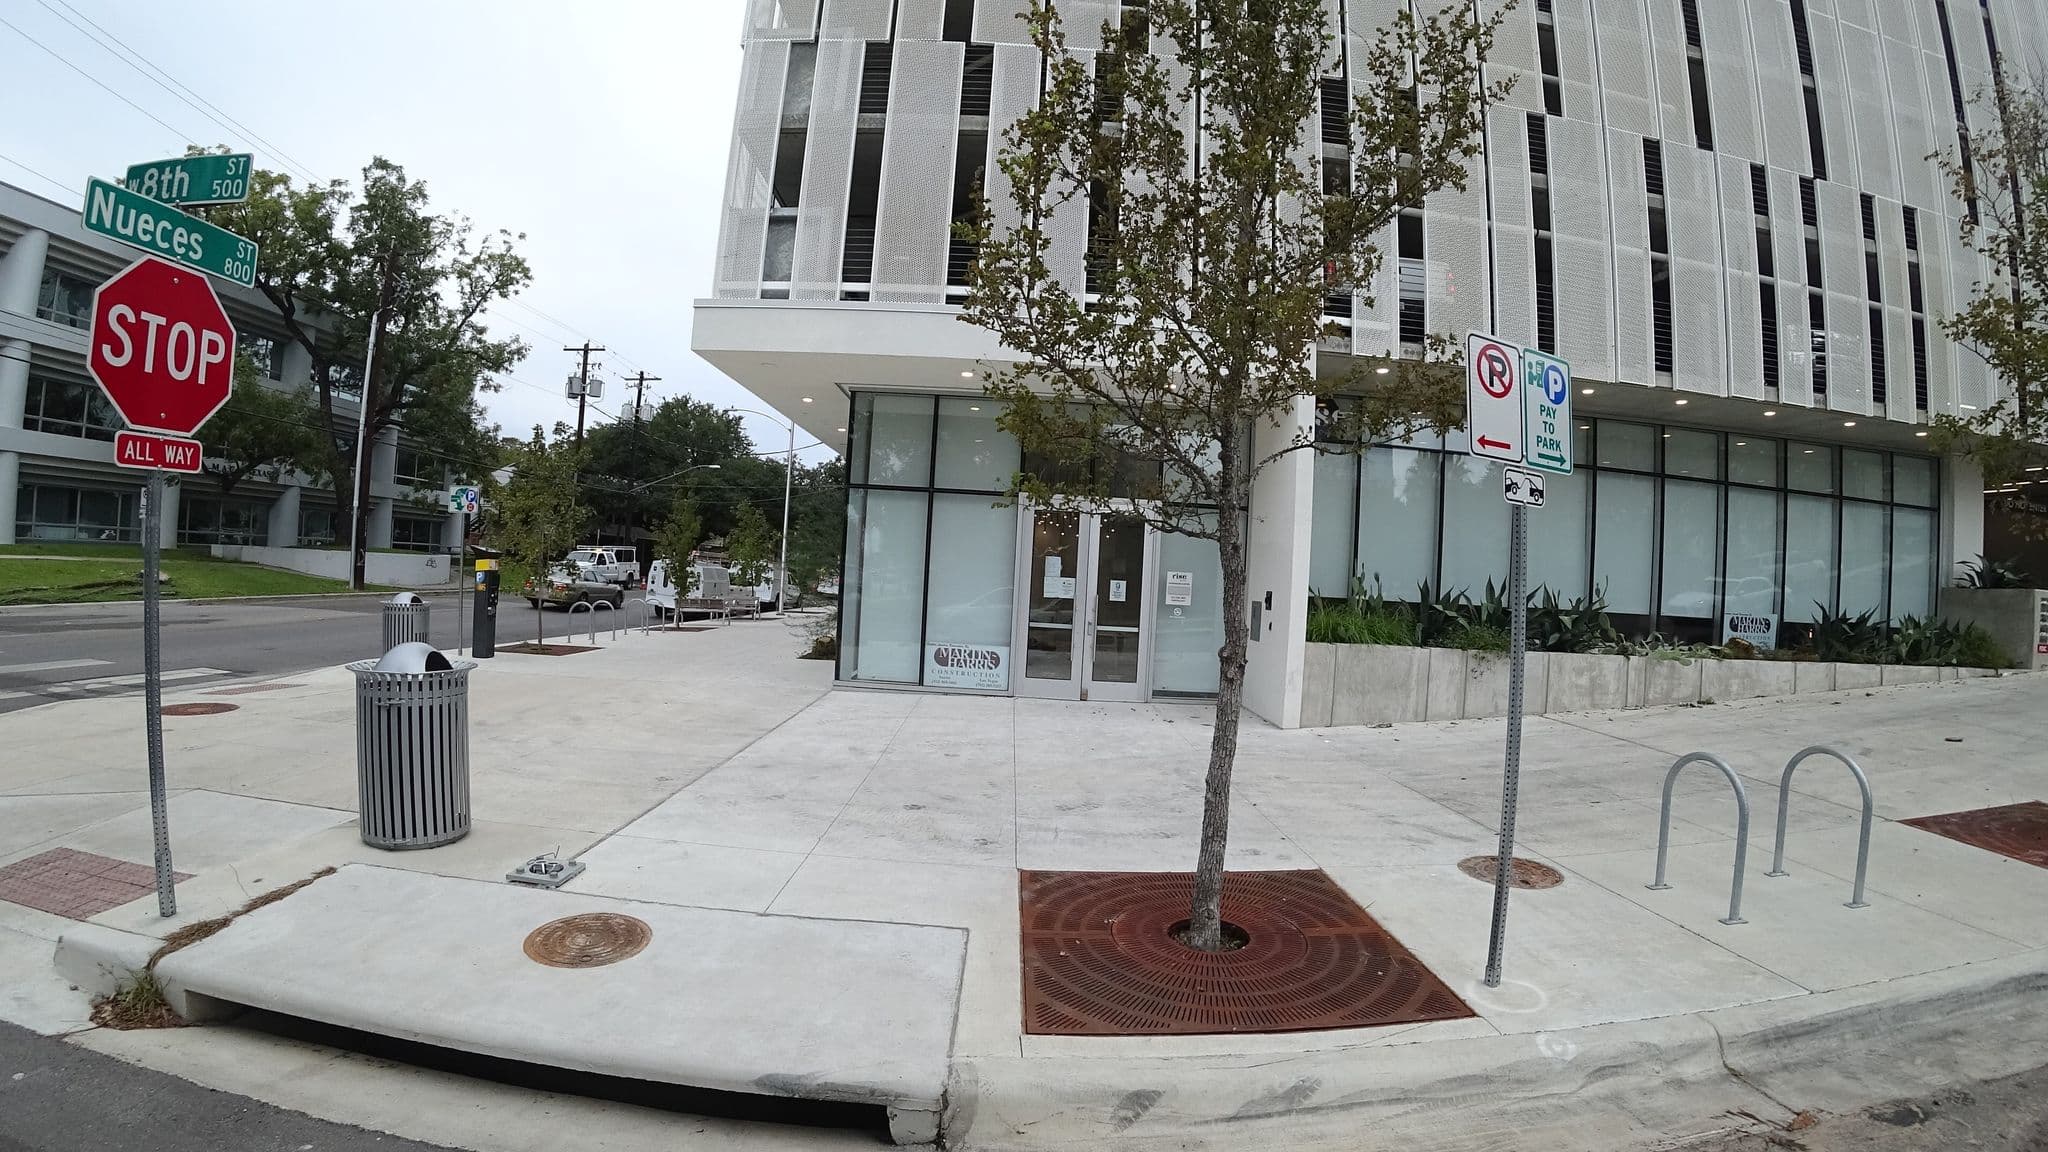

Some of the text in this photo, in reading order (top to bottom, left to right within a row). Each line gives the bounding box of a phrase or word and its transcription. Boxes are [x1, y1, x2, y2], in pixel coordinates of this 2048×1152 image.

[141, 164, 191, 199] 8th
[226, 157, 247, 176] ST
[211, 179, 243, 198] 500
[90, 186, 254, 261] Nueces ST
[224, 258, 252, 283] 800
[101, 303, 226, 385] STOP
[1548, 369, 1562, 400] P
[1539, 403, 1557, 420] PAY
[1542, 420, 1555, 435] TO
[124, 440, 194, 465] ALL WAY
[1536, 435, 1562, 453] PARK
[931, 668, 1001, 679] CONSTRUCTION
[948, 657, 996, 671] HARRIS
